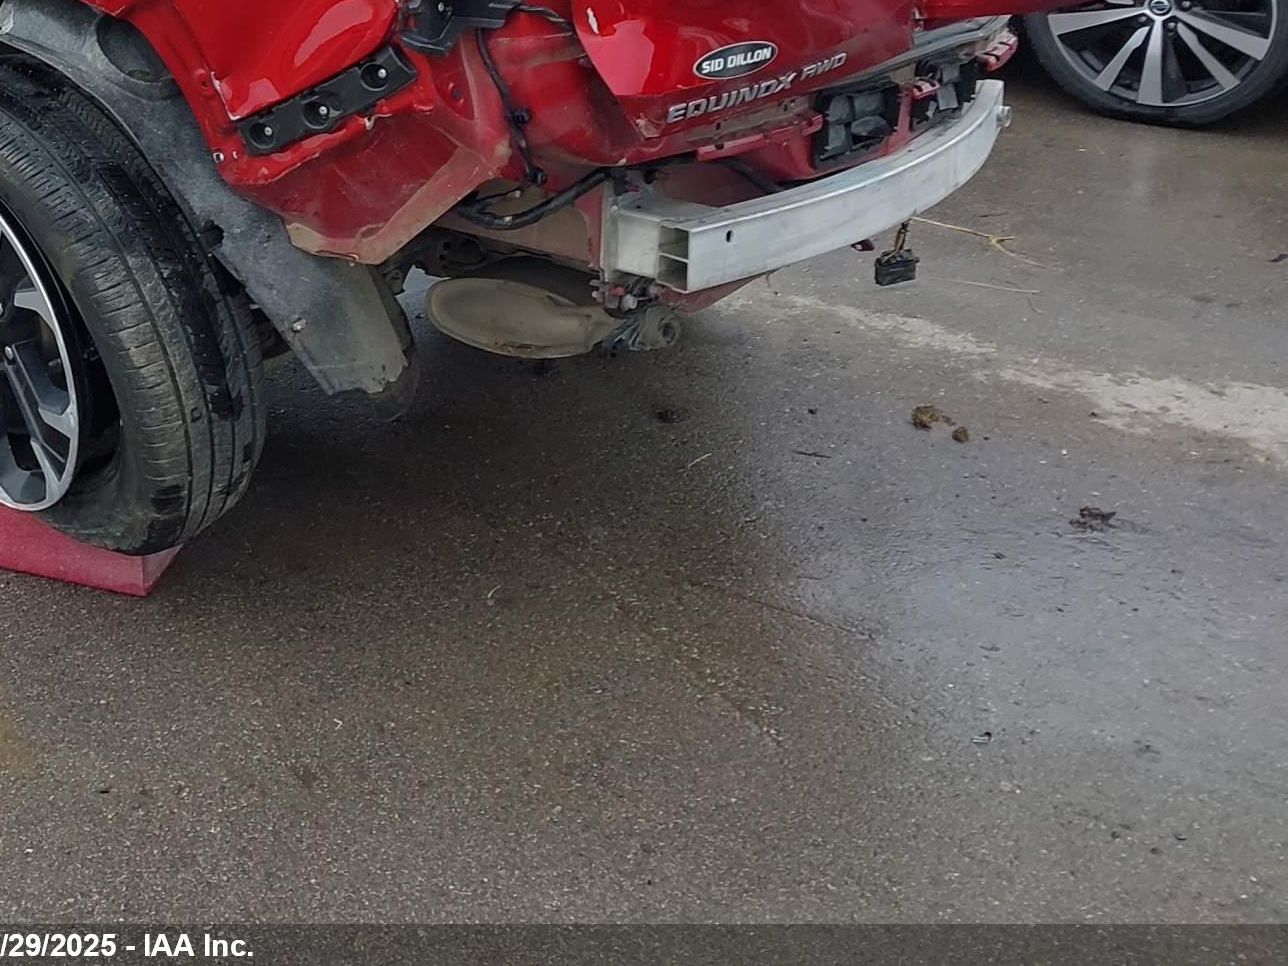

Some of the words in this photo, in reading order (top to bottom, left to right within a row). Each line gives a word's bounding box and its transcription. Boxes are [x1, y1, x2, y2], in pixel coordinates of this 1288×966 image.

[701, 57, 724, 74] SID
[727, 47, 772, 68] DILLON
[666, 71, 798, 123] EQUINOX
[800, 52, 848, 81] AWD
